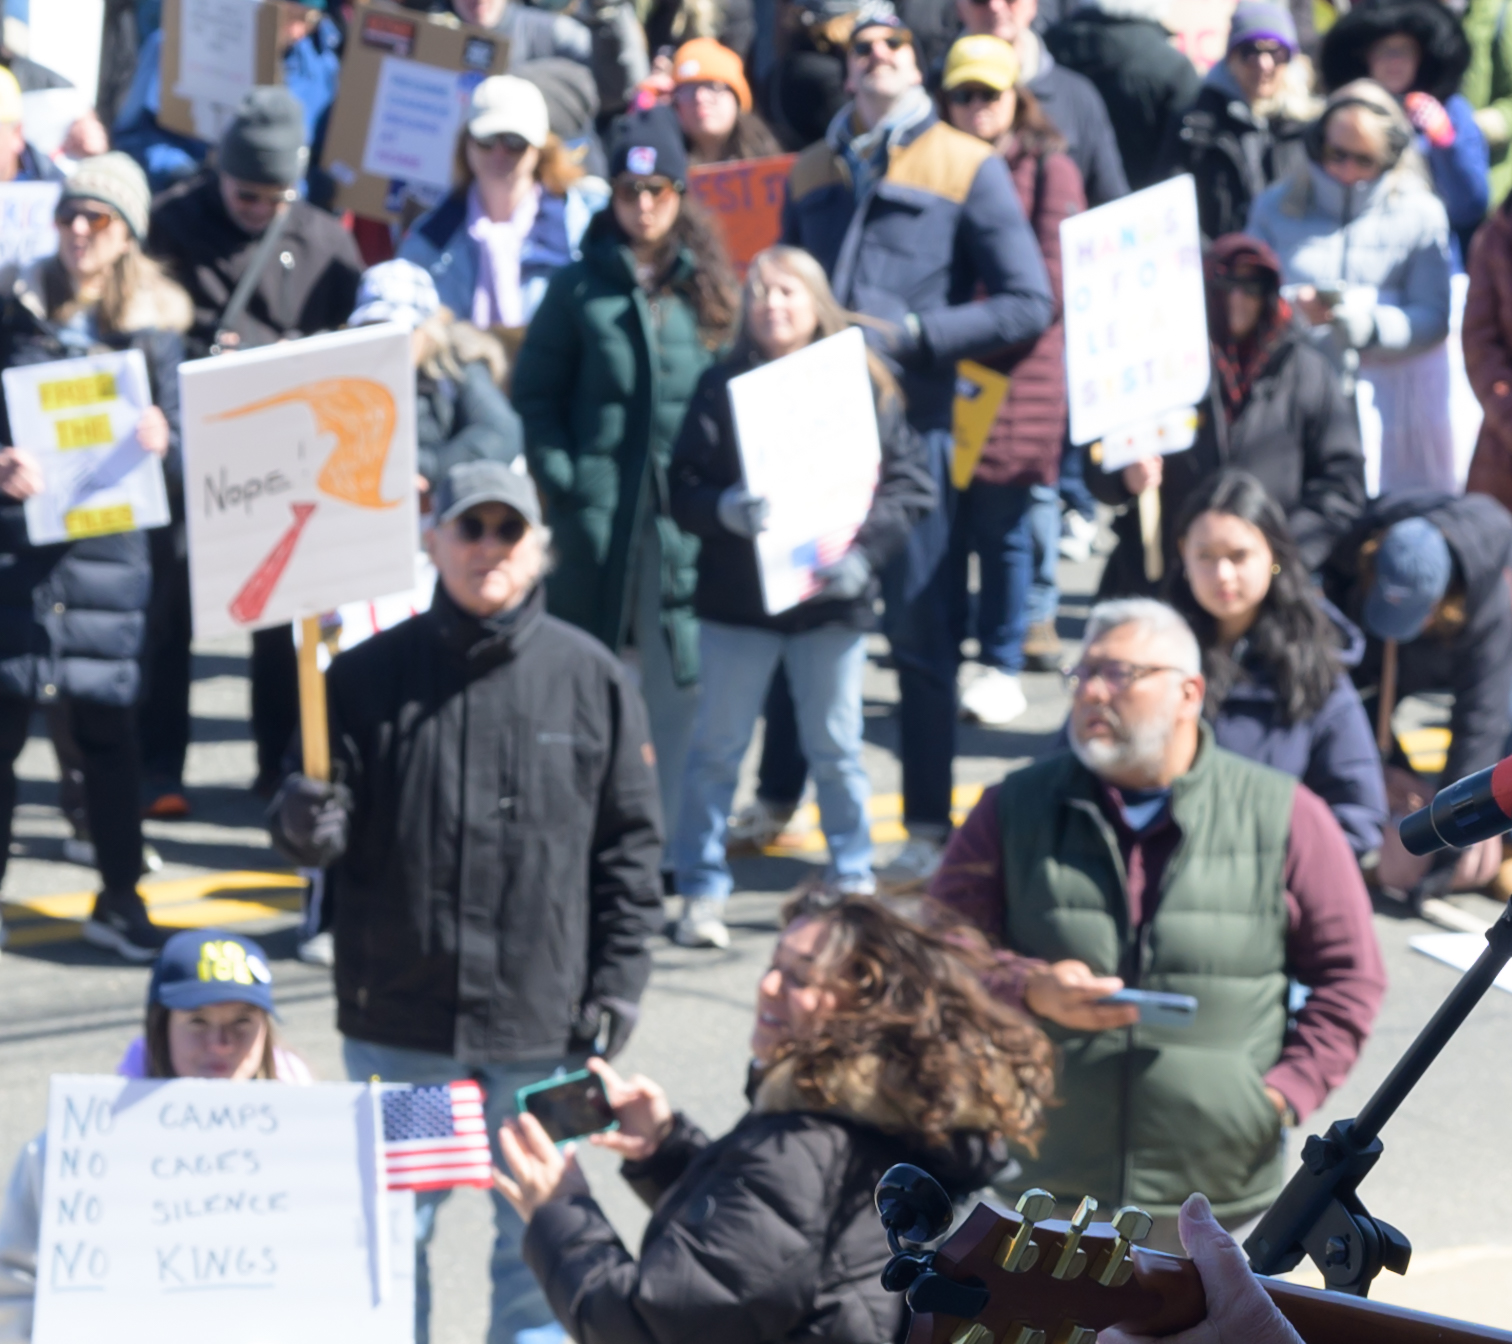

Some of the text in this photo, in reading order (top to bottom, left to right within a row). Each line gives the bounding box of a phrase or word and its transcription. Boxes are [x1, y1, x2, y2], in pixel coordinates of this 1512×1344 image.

[62, 1095, 280, 1141] NO CAMPS
[58, 1148, 109, 1184] NO
[54, 1188, 289, 1228] NO SILENCE
[53, 1242, 279, 1284] NO KINGS
